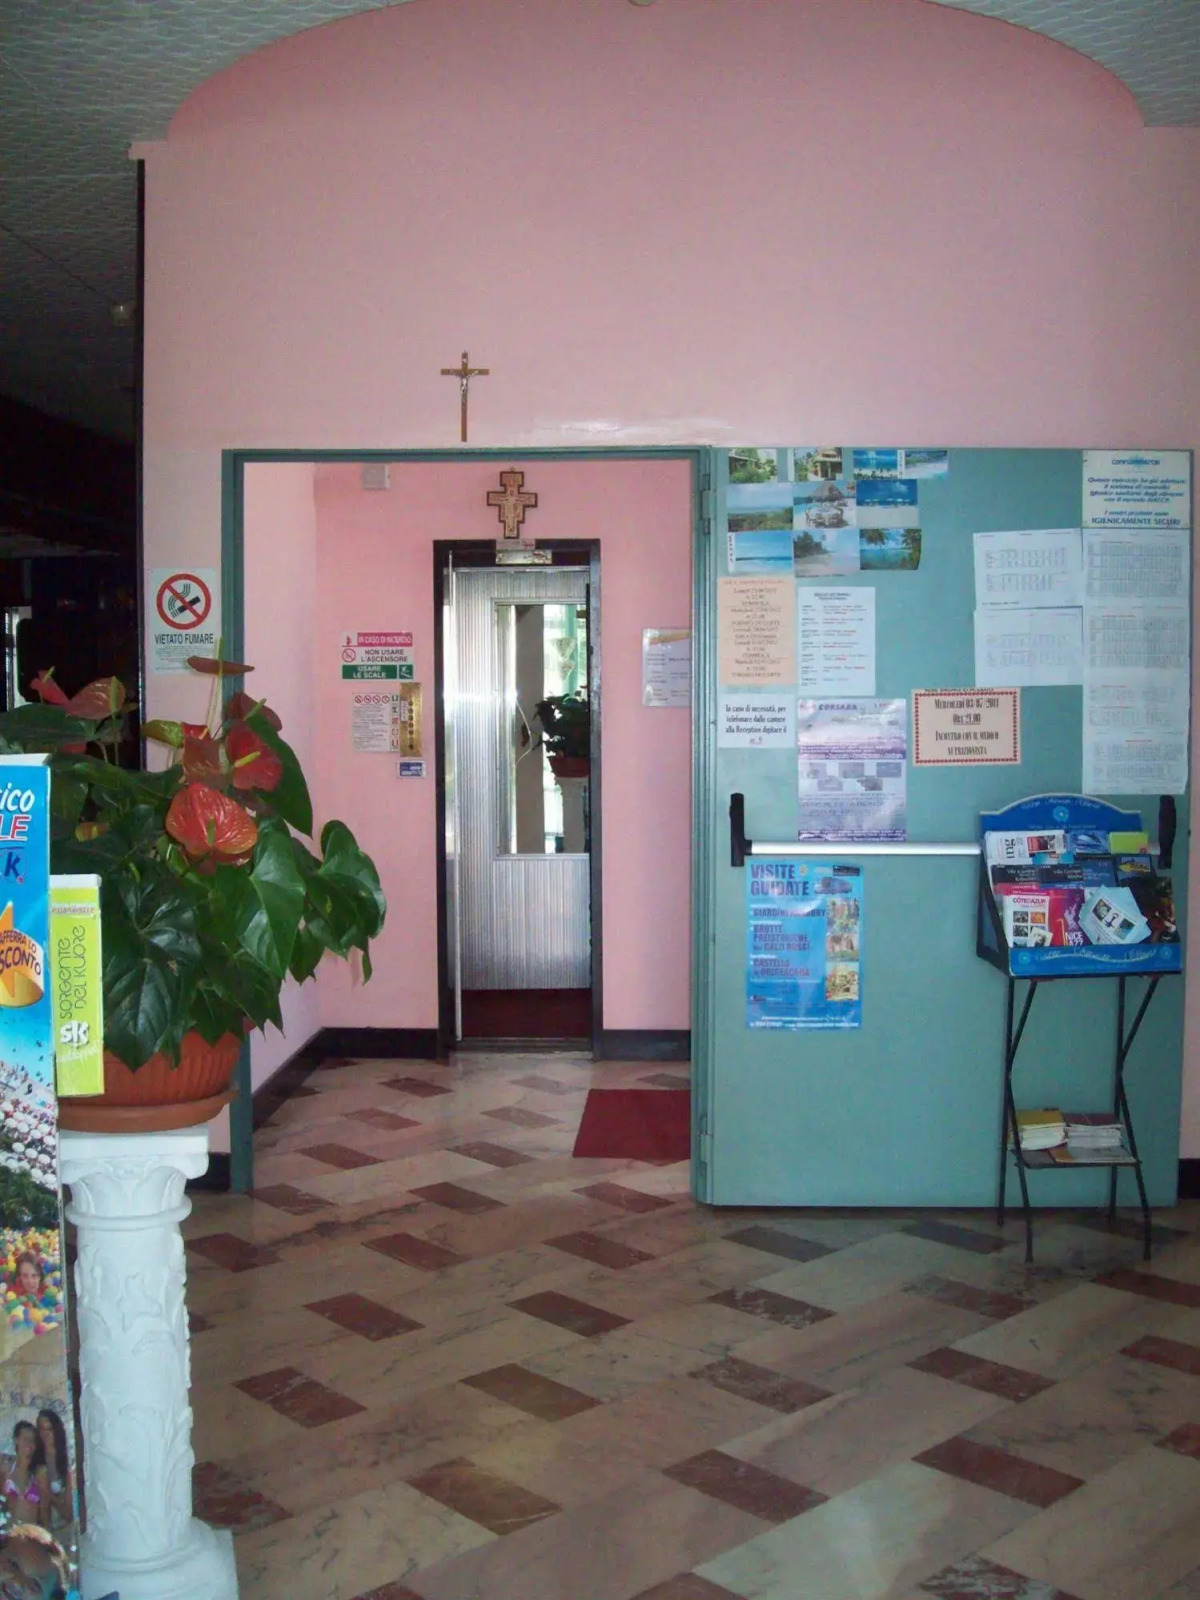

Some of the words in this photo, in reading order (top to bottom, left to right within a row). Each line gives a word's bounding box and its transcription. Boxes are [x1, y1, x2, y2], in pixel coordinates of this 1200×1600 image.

[154, 633, 182, 645] VIETATO
[184, 633, 214, 645] FUMARE
[777, 706, 786, 714] per
[0, 782, 36, 812] ico
[750, 864, 795, 879] VISITE
[750, 881, 809, 896] GUIDATE
